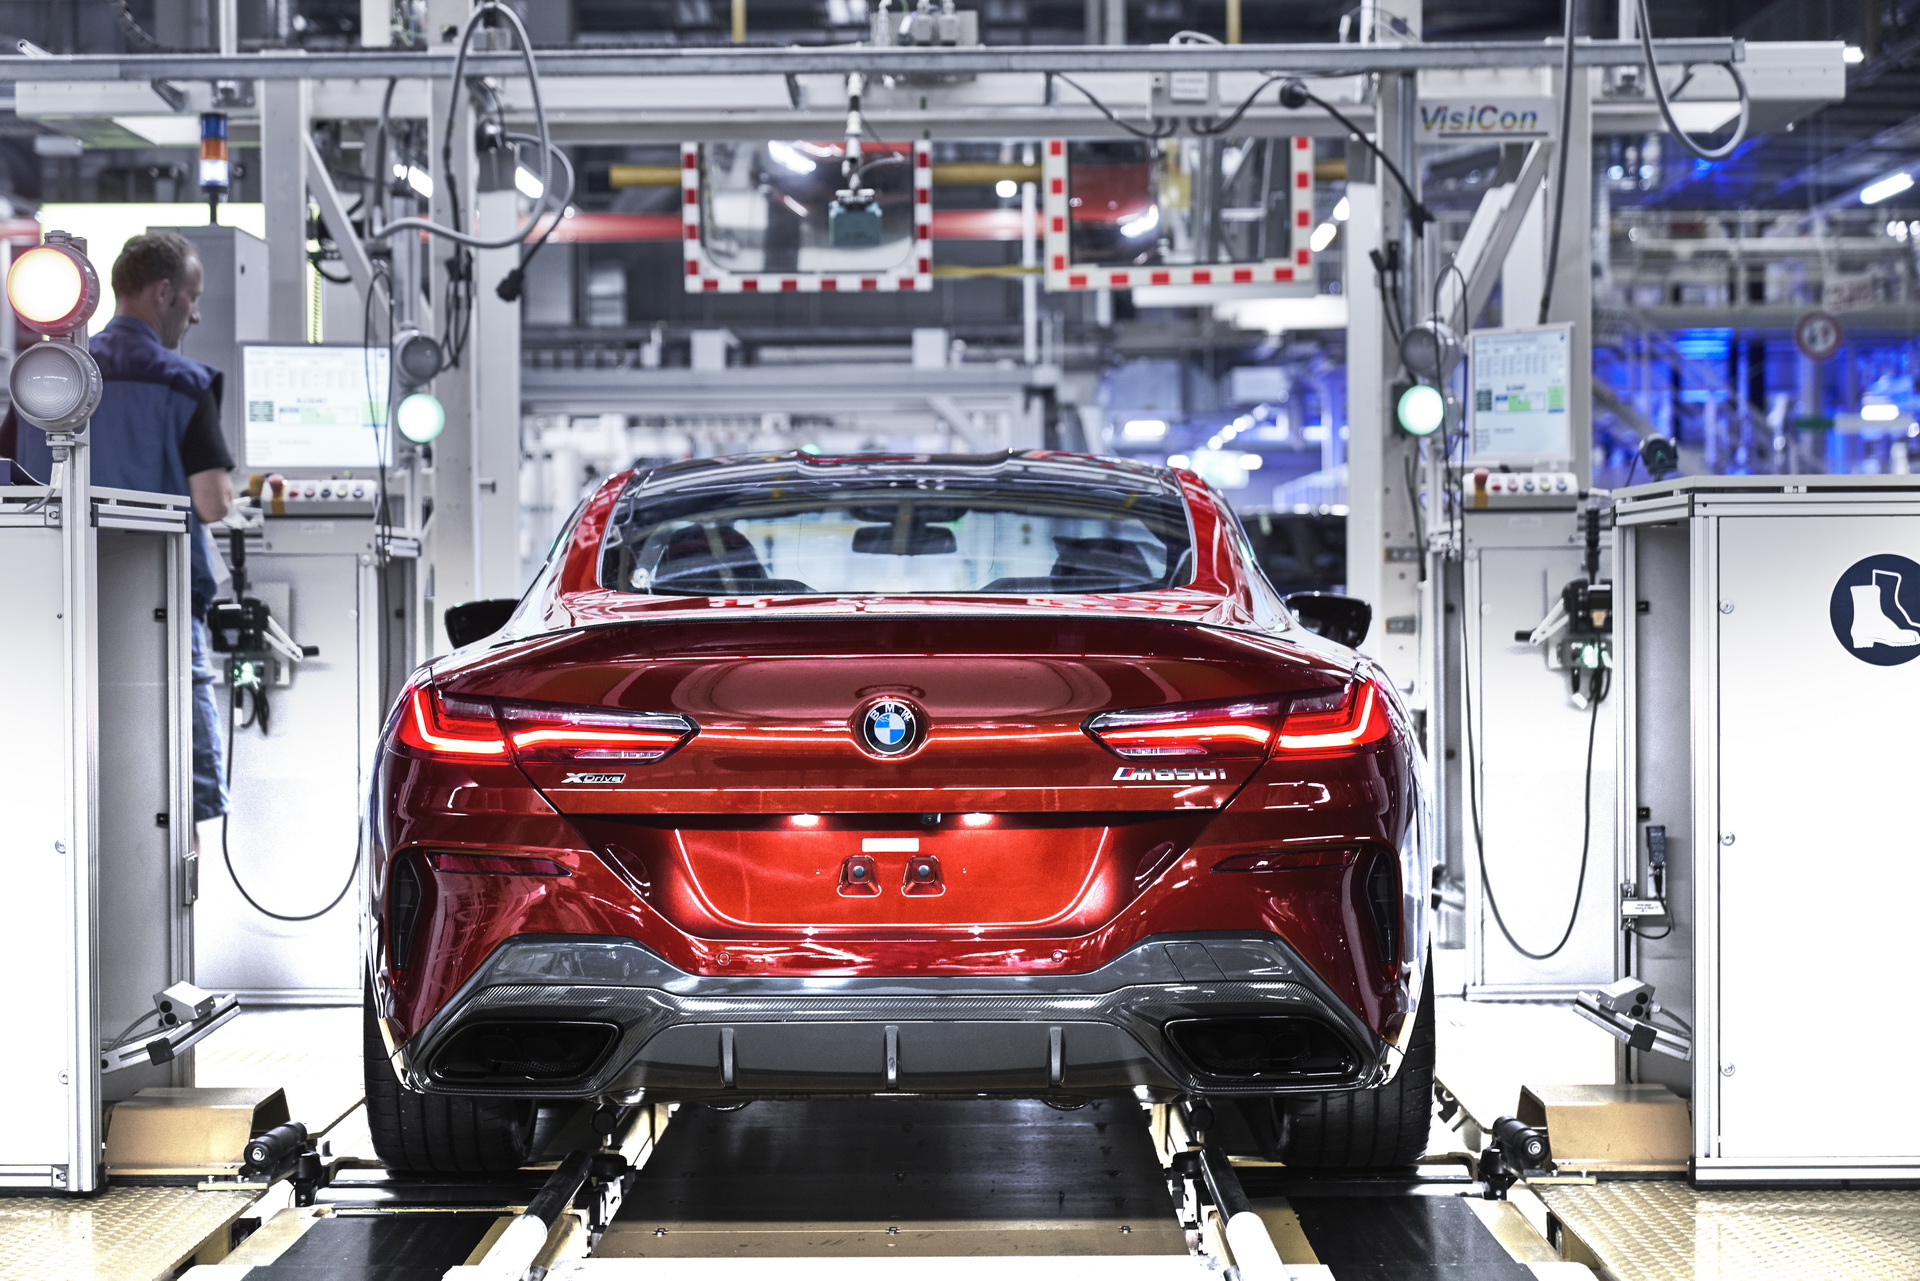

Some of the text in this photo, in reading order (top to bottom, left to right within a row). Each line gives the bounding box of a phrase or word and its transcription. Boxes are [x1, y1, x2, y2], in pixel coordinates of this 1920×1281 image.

[1420, 105, 1538, 131] VisiCon
[870, 703, 912, 722] BMW
[1129, 767, 1227, 781] M850i
